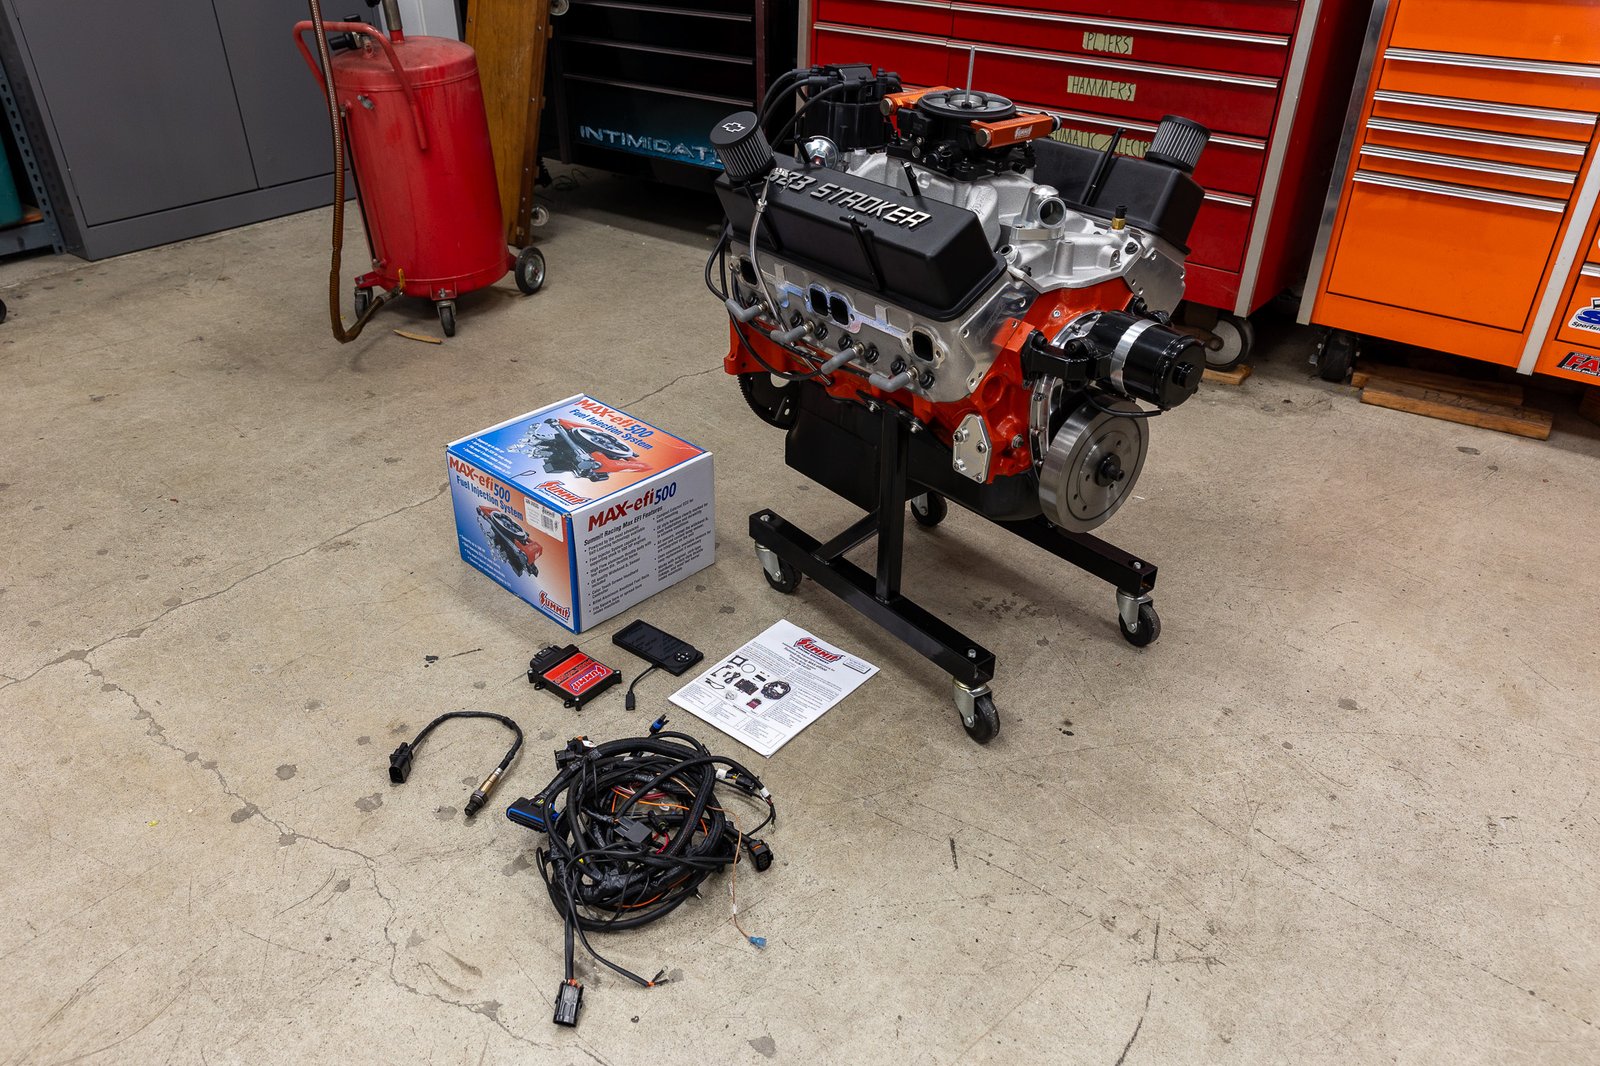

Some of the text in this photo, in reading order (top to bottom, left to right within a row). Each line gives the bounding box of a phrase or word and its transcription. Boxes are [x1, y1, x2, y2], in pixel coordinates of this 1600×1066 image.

[1086, 32, 1130, 54] PLIERS
[1071, 76, 1135, 101] HAMMERS
[810, 183, 932, 228] STROKER
[1571, 321, 1600, 331] Sports
[1565, 355, 1600, 372] FA
[569, 409, 654, 450] Fuel Injection System
[456, 475, 471, 490] Fuel
[471, 482, 499, 507] Injection
[499, 500, 523, 521] System
[539, 590, 570, 620] SUMMIT
[794, 637, 845, 663] SUMMIT
